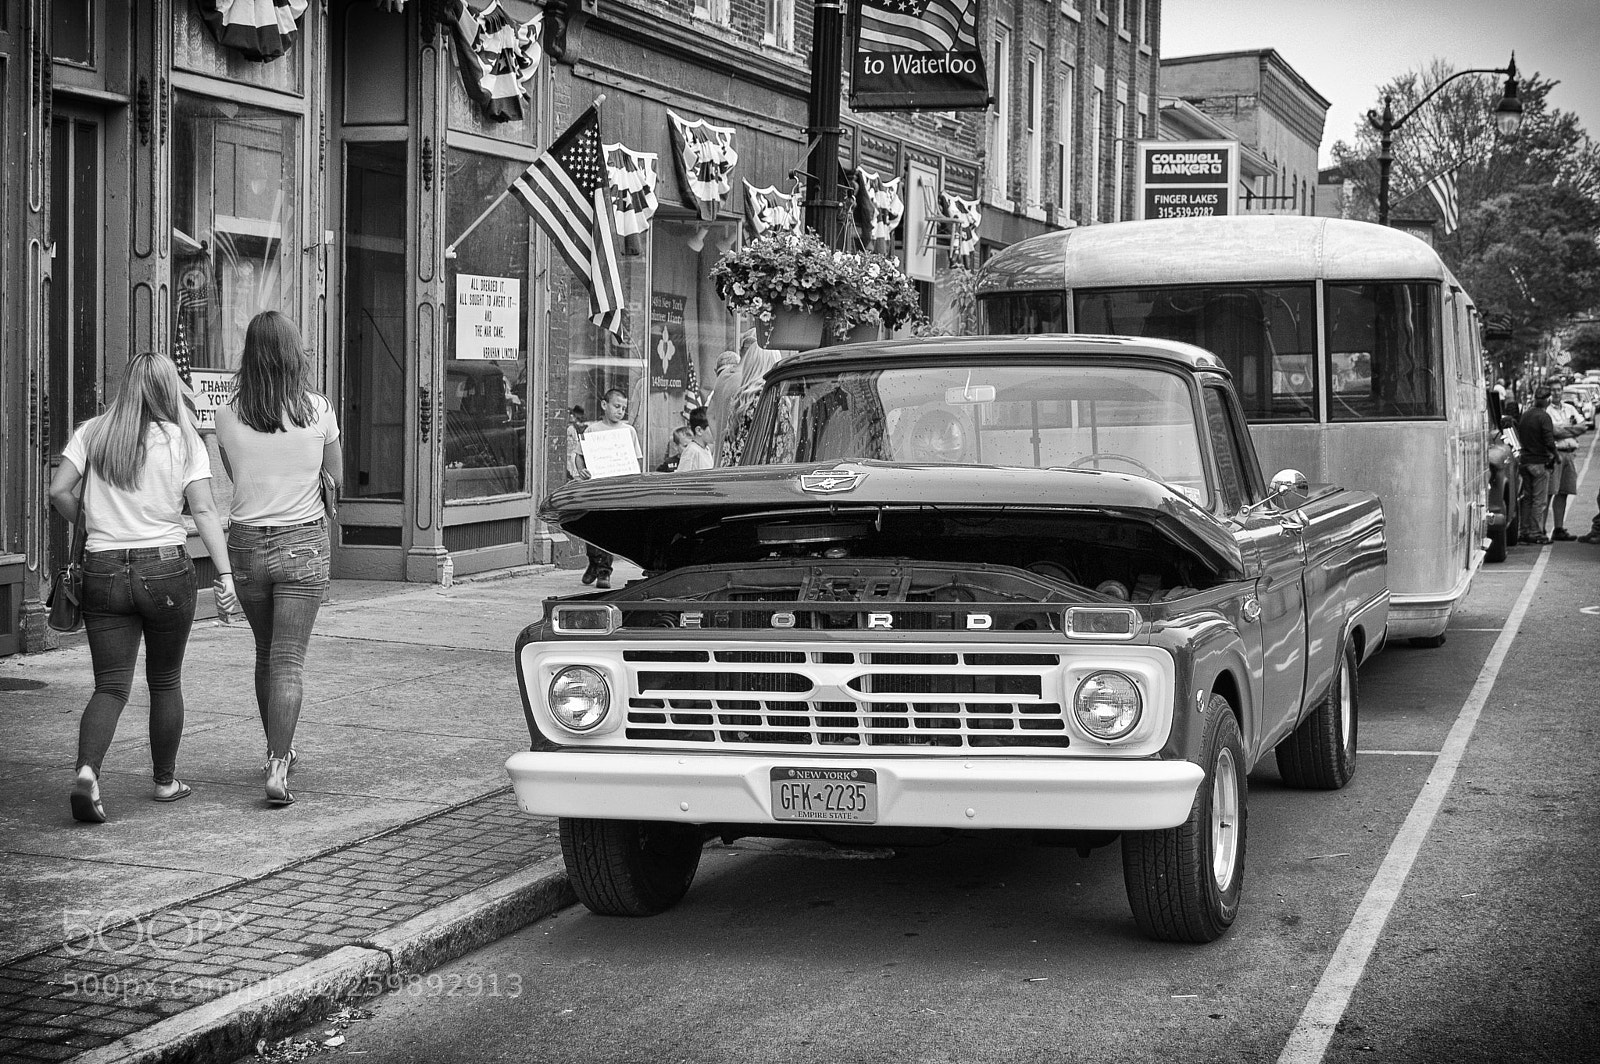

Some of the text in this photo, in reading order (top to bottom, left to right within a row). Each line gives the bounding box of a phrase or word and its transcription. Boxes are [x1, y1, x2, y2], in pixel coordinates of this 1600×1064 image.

[863, 52, 977, 75] to Waterloo
[1151, 153, 1222, 164] COLDWELL
[1152, 164, 1209, 176] BANKER
[1154, 194, 1219, 205] FINGER LAKES
[470, 277, 479, 291] ALL
[459, 293, 467, 306] ALL
[486, 294, 492, 307] TO
[484, 310, 492, 323] AND
[474, 324, 483, 337] THE
[482, 347, 518, 360] ABRAHAM LINCOLN
[679, 612, 993, 630] FORD
[796, 770, 851, 781] NEW YORK
[797, 811, 852, 820] EMPIRE STATE
